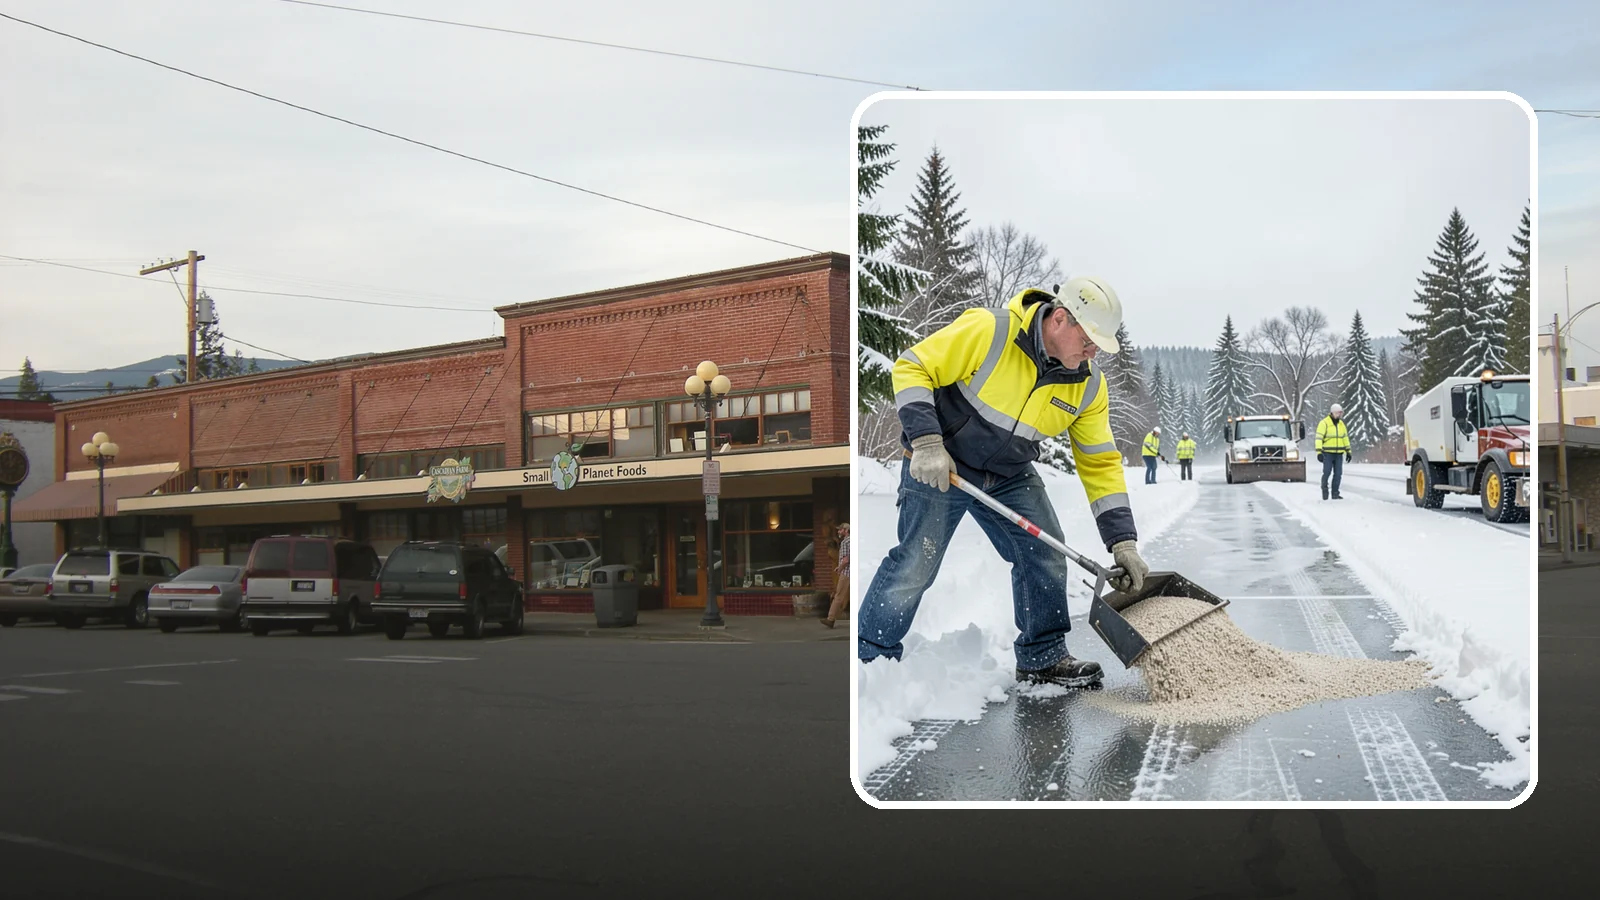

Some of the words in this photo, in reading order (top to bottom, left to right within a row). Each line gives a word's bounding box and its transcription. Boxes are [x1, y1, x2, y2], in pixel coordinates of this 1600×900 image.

[523, 471, 549, 482] Small
[583, 468, 614, 479] Planet
[617, 464, 647, 477] Foods
